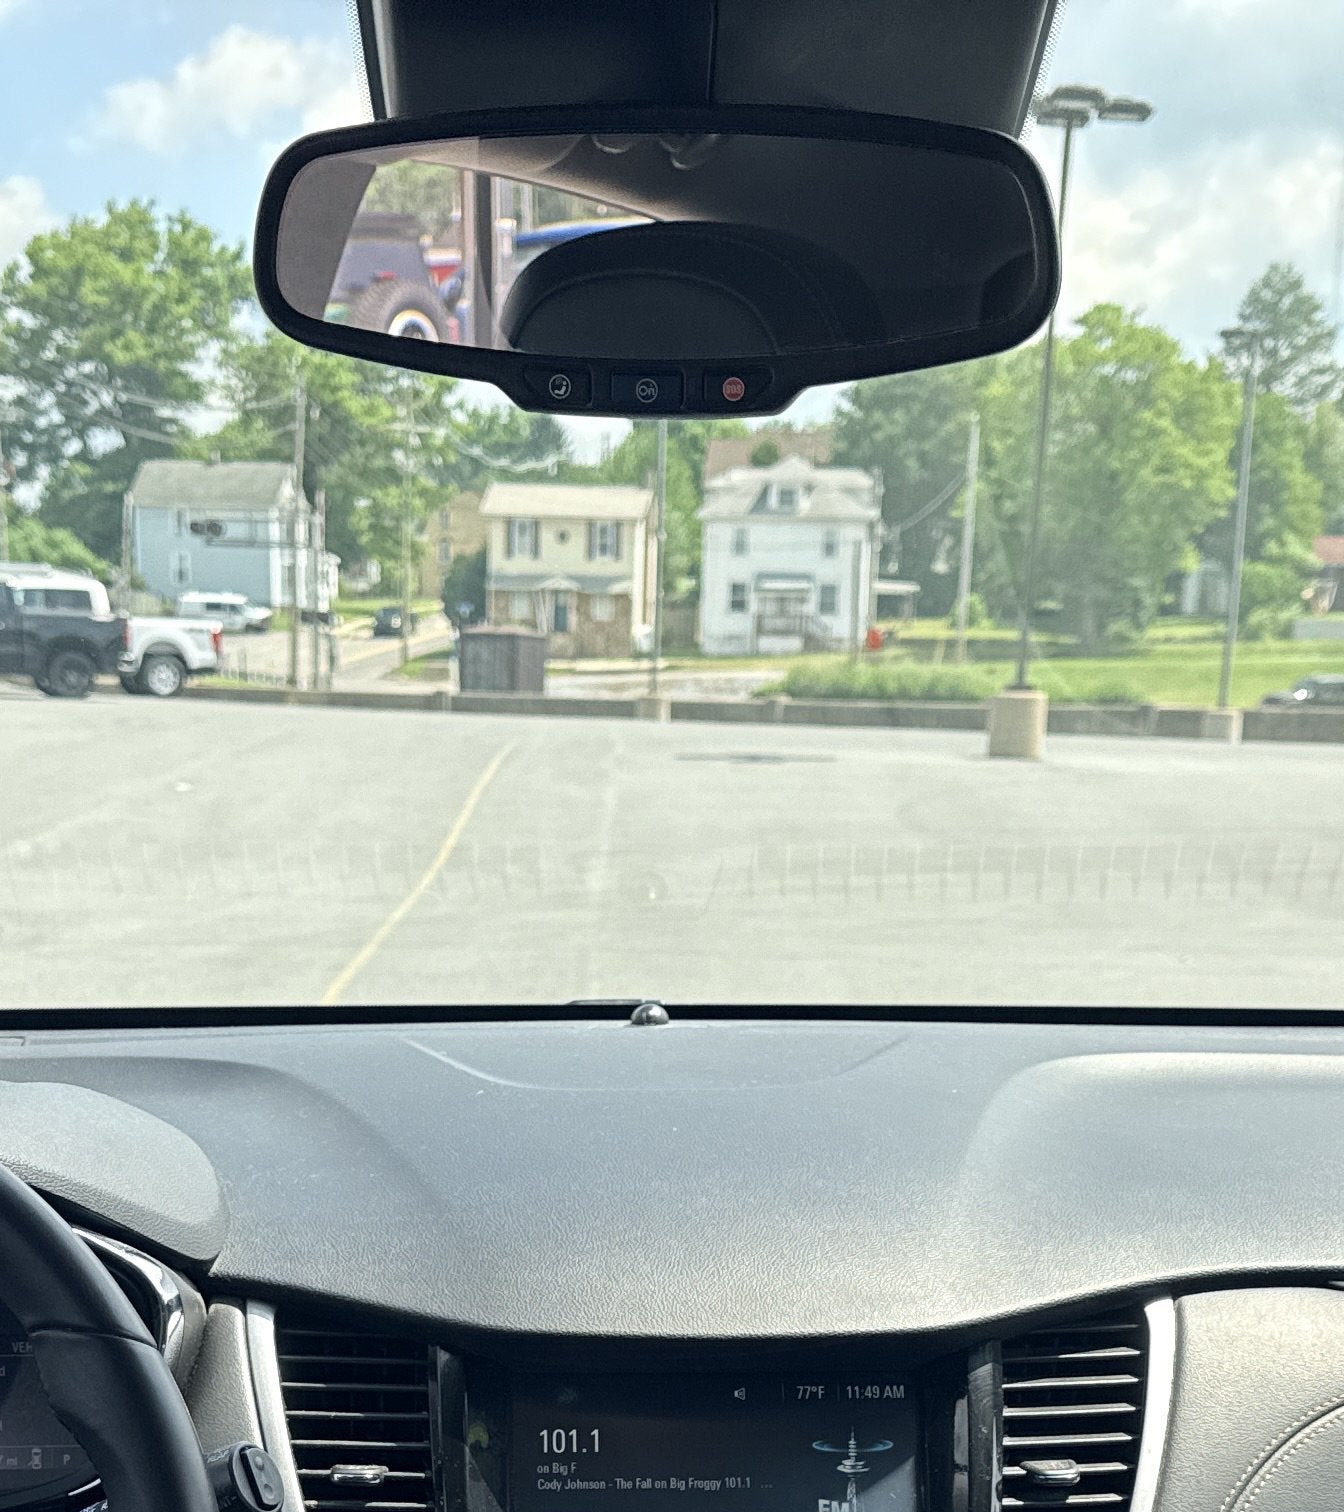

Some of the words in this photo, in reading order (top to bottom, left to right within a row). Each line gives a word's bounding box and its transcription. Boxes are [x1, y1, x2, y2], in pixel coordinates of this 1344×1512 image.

[796, 1385, 825, 1400] 77°F
[846, 1385, 880, 1399] 11:49
[883, 1385, 905, 1399] AM
[539, 1428, 600, 1454] 101.1
[63, 1455, 71, 1466] P
[537, 1465, 550, 1474] on
[552, 1463, 568, 1476] Big
[571, 1463, 577, 1473] F
[537, 1479, 562, 1492] Cody
[564, 1478, 606, 1490] Johnson
[614, 1478, 633, 1489] The
[635, 1477, 652, 1489] Fall
[655, 1480, 667, 1489] on
[670, 1477, 686, 1491] Big
[688, 1477, 722, 1491] Froggy
[724, 1477, 751, 1489] 101.1
